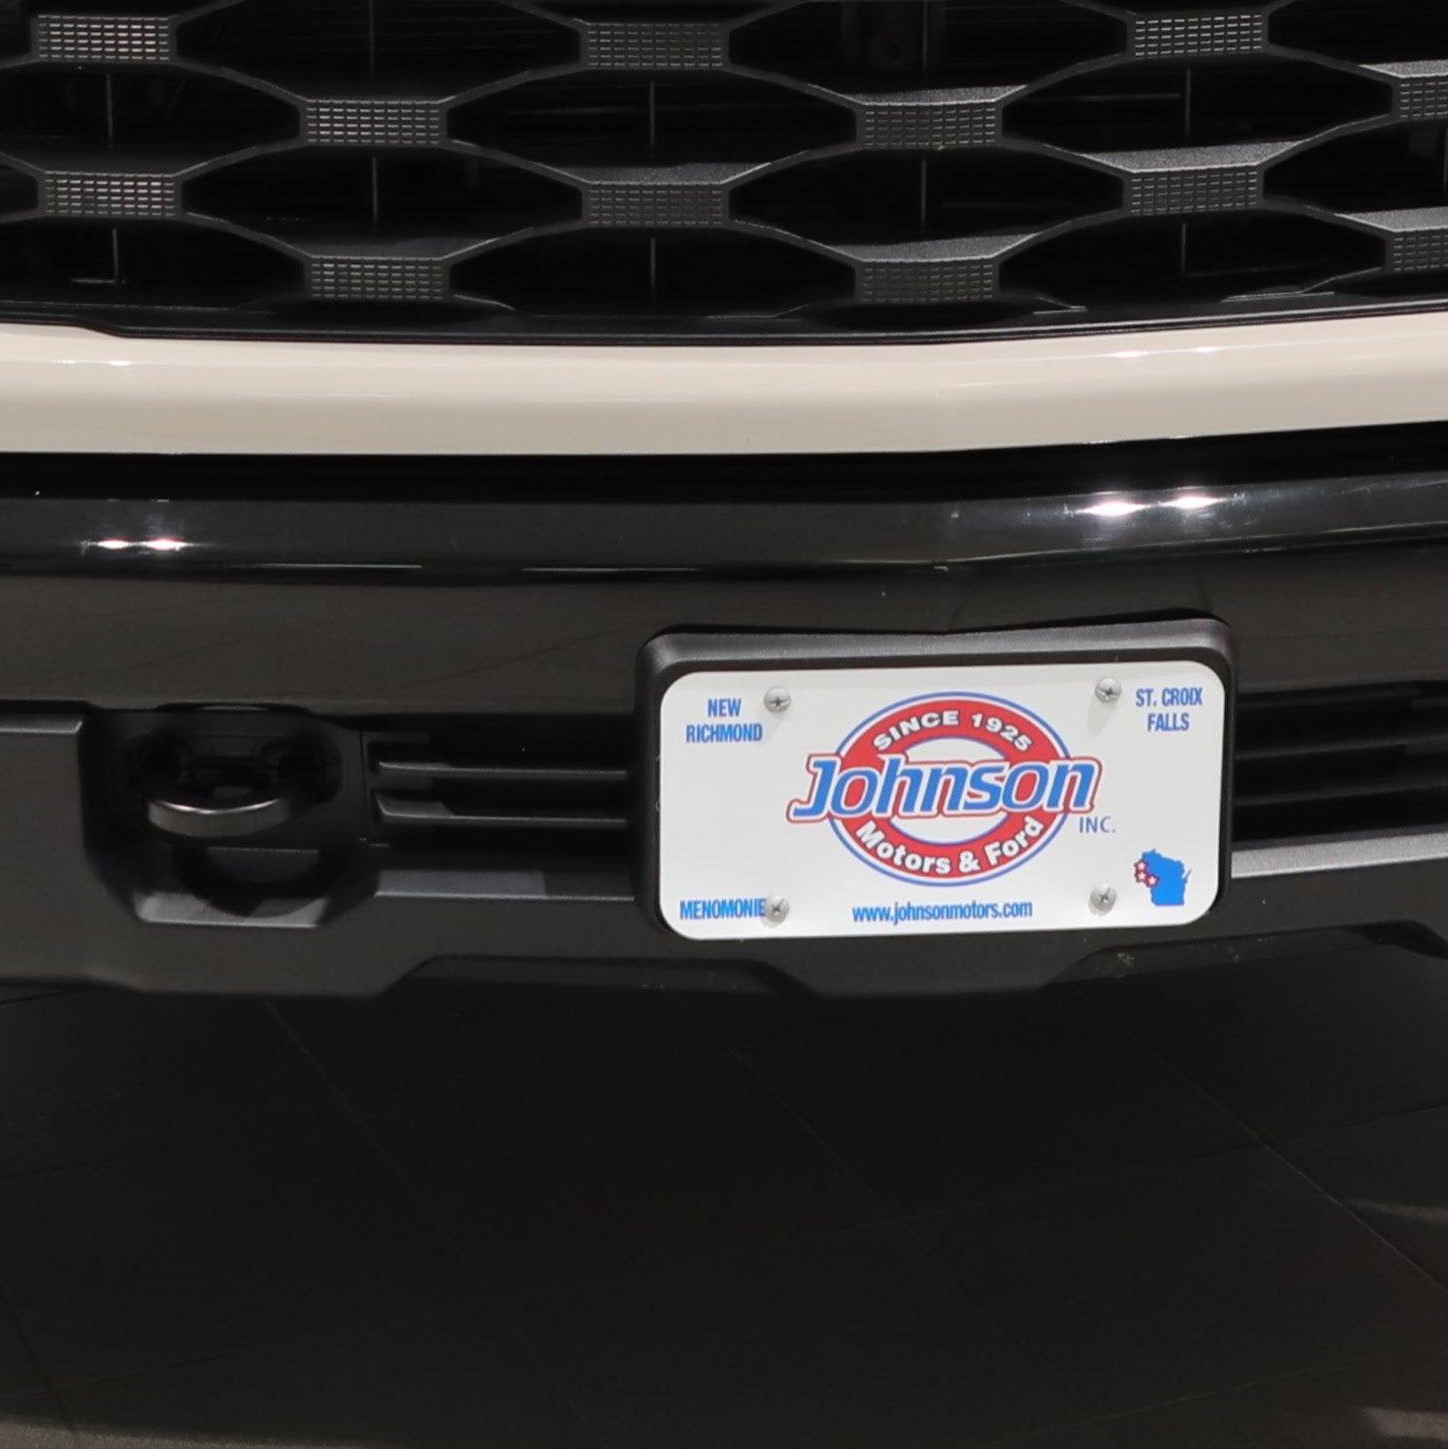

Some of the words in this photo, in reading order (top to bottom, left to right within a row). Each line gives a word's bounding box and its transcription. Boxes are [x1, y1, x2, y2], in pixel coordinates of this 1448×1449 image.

[707, 698, 742, 717] NEW
[1135, 688, 1157, 707] ST.
[1161, 687, 1204, 706] CROIX
[685, 723, 763, 743] RICHMOND
[872, 709, 960, 752] SINCE
[970, 712, 1033, 752] 1925
[1147, 712, 1190, 732] FALLS
[789, 754, 1100, 819] Johnson
[1078, 816, 1117, 834] INC.
[855, 819, 952, 875] Motors
[957, 850, 981, 874] &
[983, 814, 1045, 866] Ford
[679, 897, 767, 921] MENOMONIE
[851, 900, 1033, 926] www.johnsonmotors.com
